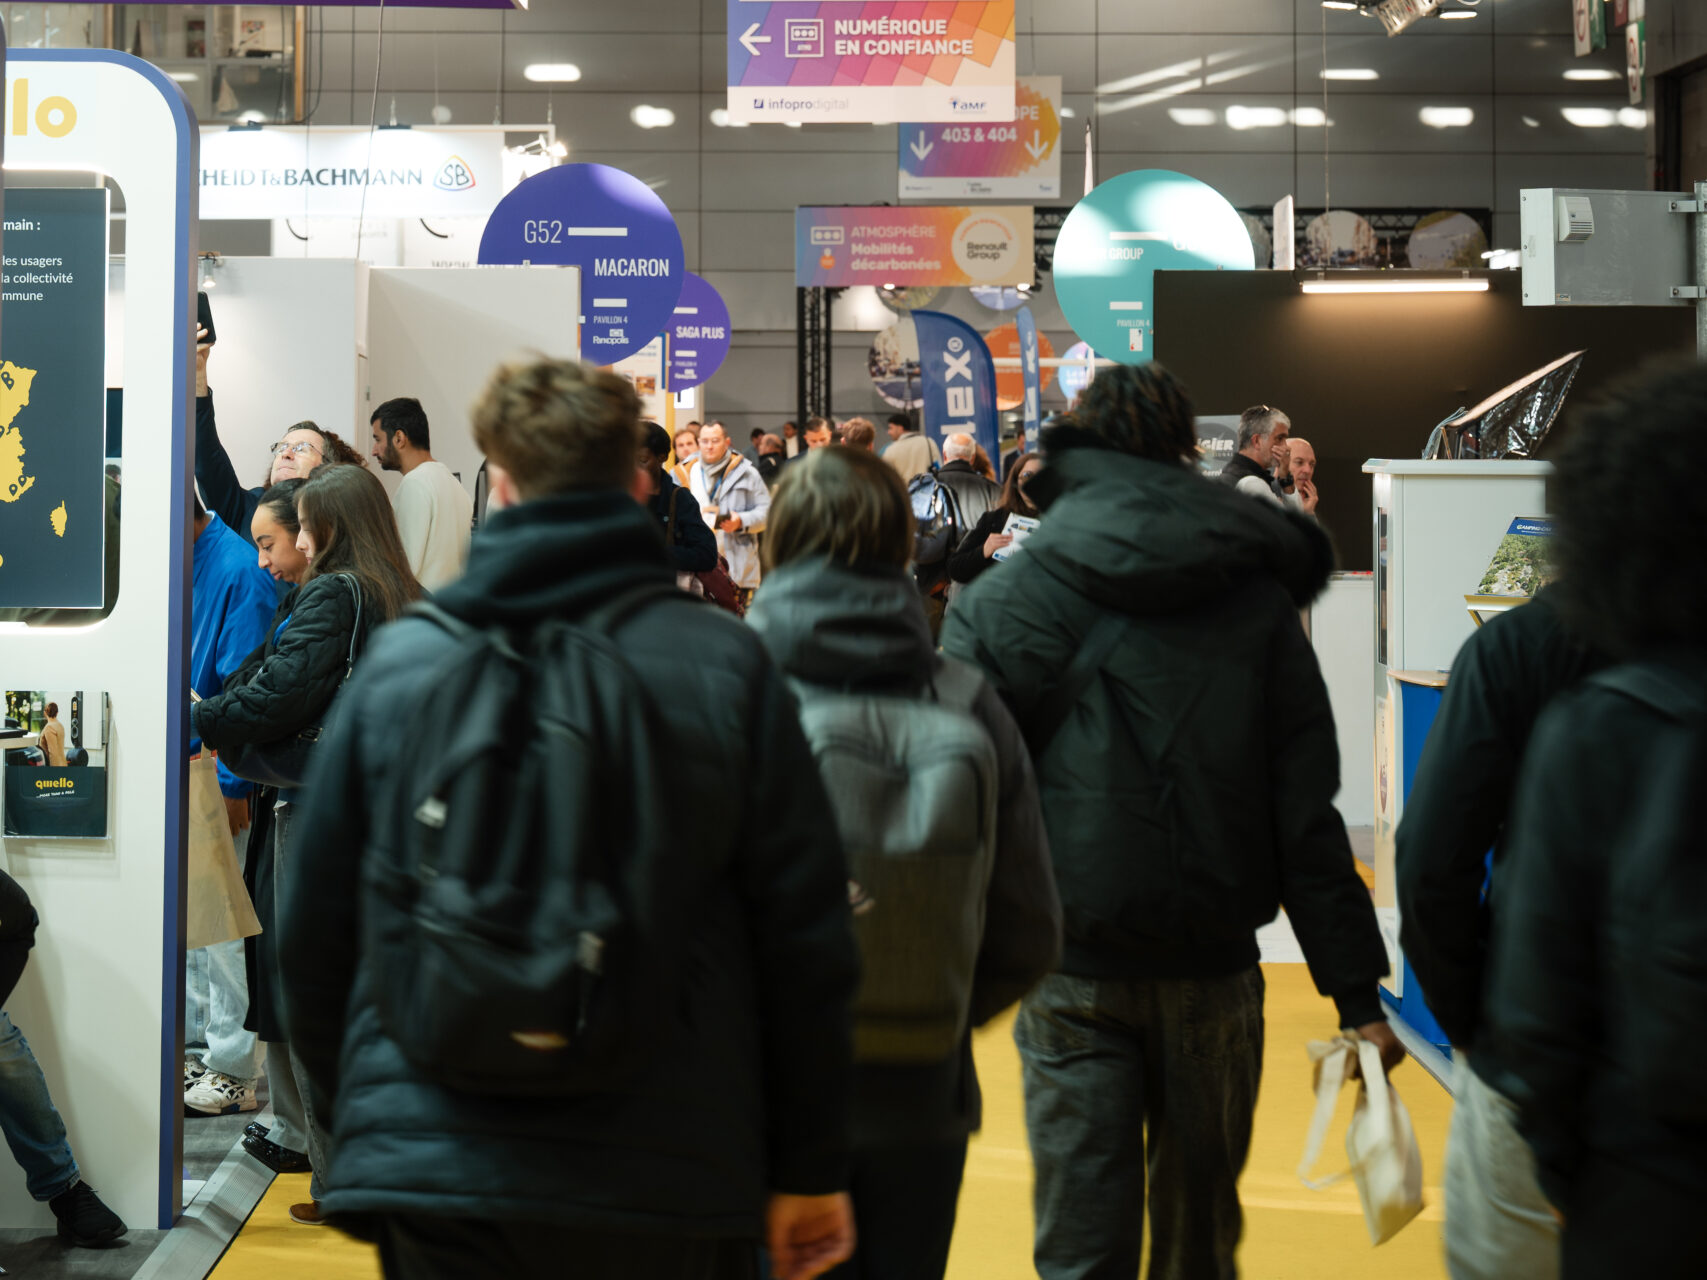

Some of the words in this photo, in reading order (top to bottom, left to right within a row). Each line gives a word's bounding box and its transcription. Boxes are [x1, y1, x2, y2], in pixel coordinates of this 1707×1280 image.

[834, 16, 948, 36] NUMÉRIQUE
[834, 39, 861, 55] EN
[863, 39, 974, 55] CONFIANCE
[12, 77, 78, 139] lo
[941, 127, 971, 142] 403
[973, 127, 985, 142] &
[987, 127, 1018, 142] 404
[439, 164, 471, 187] SB
[524, 220, 563, 244] G52
[851, 225, 936, 238] ATMOSPHÈRE
[851, 242, 914, 255] Mobilités
[966, 241, 1008, 251] Renault
[966, 250, 1001, 261] Group
[1109, 248, 1144, 260] GROUP
[2, 255, 18, 266] les
[20, 257, 63, 268] usagers
[594, 258, 669, 277] MACARON
[851, 258, 942, 271] décarbonées
[13, 272, 74, 284] collectivité
[593, 316, 622, 324] PAVILLON
[623, 316, 628, 324] 4
[1116, 319, 1145, 327] PAVILLON
[676, 326, 700, 339] SAGA
[701, 326, 725, 339] PLUS
